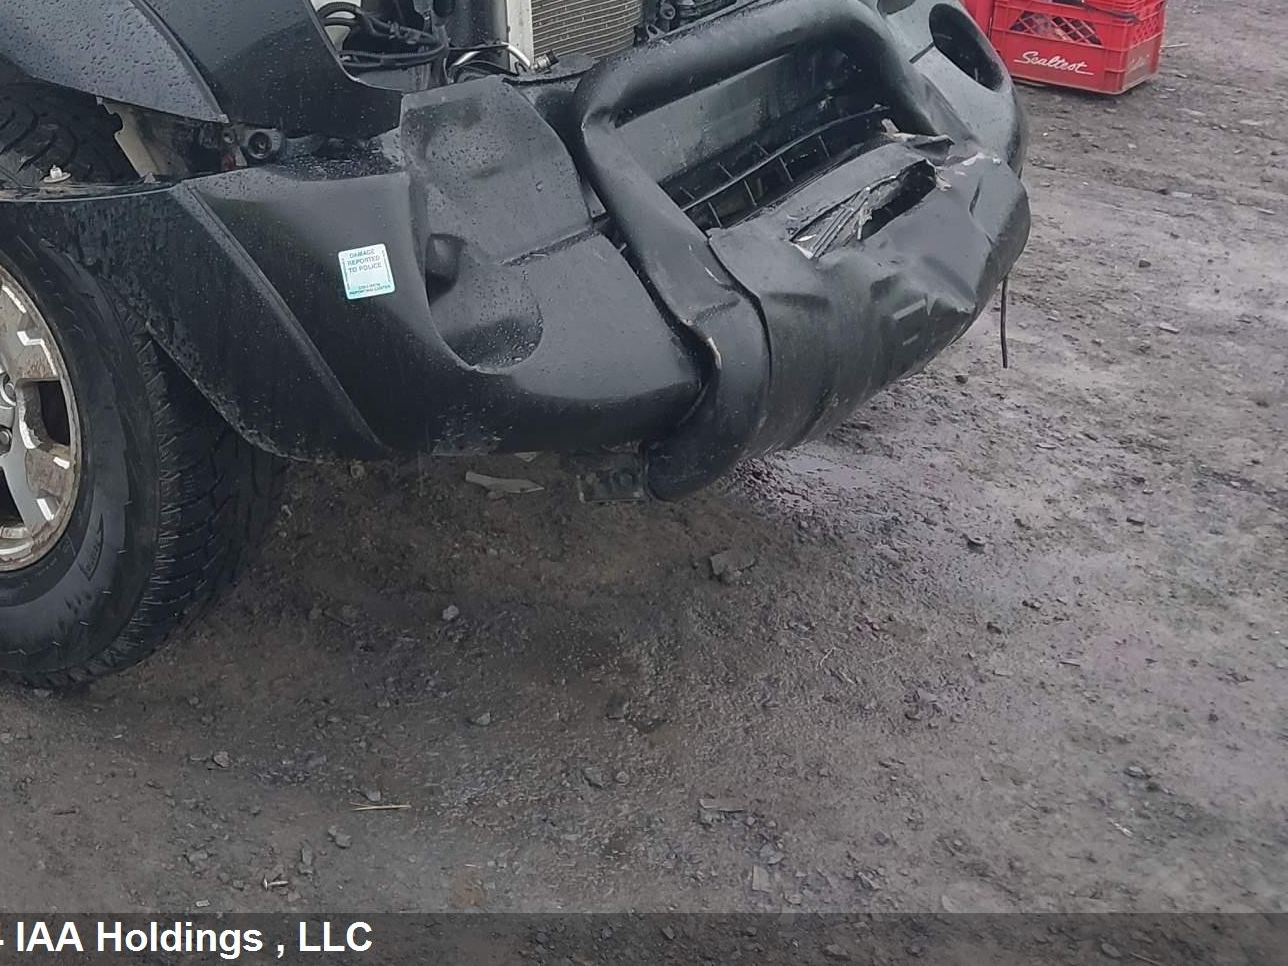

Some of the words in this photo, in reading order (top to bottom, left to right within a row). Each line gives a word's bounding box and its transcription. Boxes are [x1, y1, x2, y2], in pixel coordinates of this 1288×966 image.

[1014, 50, 1095, 76] Sealtest
[349, 249, 375, 259] DAMAGE
[347, 255, 380, 266] REPORTED
[349, 266, 358, 274] TO
[358, 262, 383, 272] POLICE
